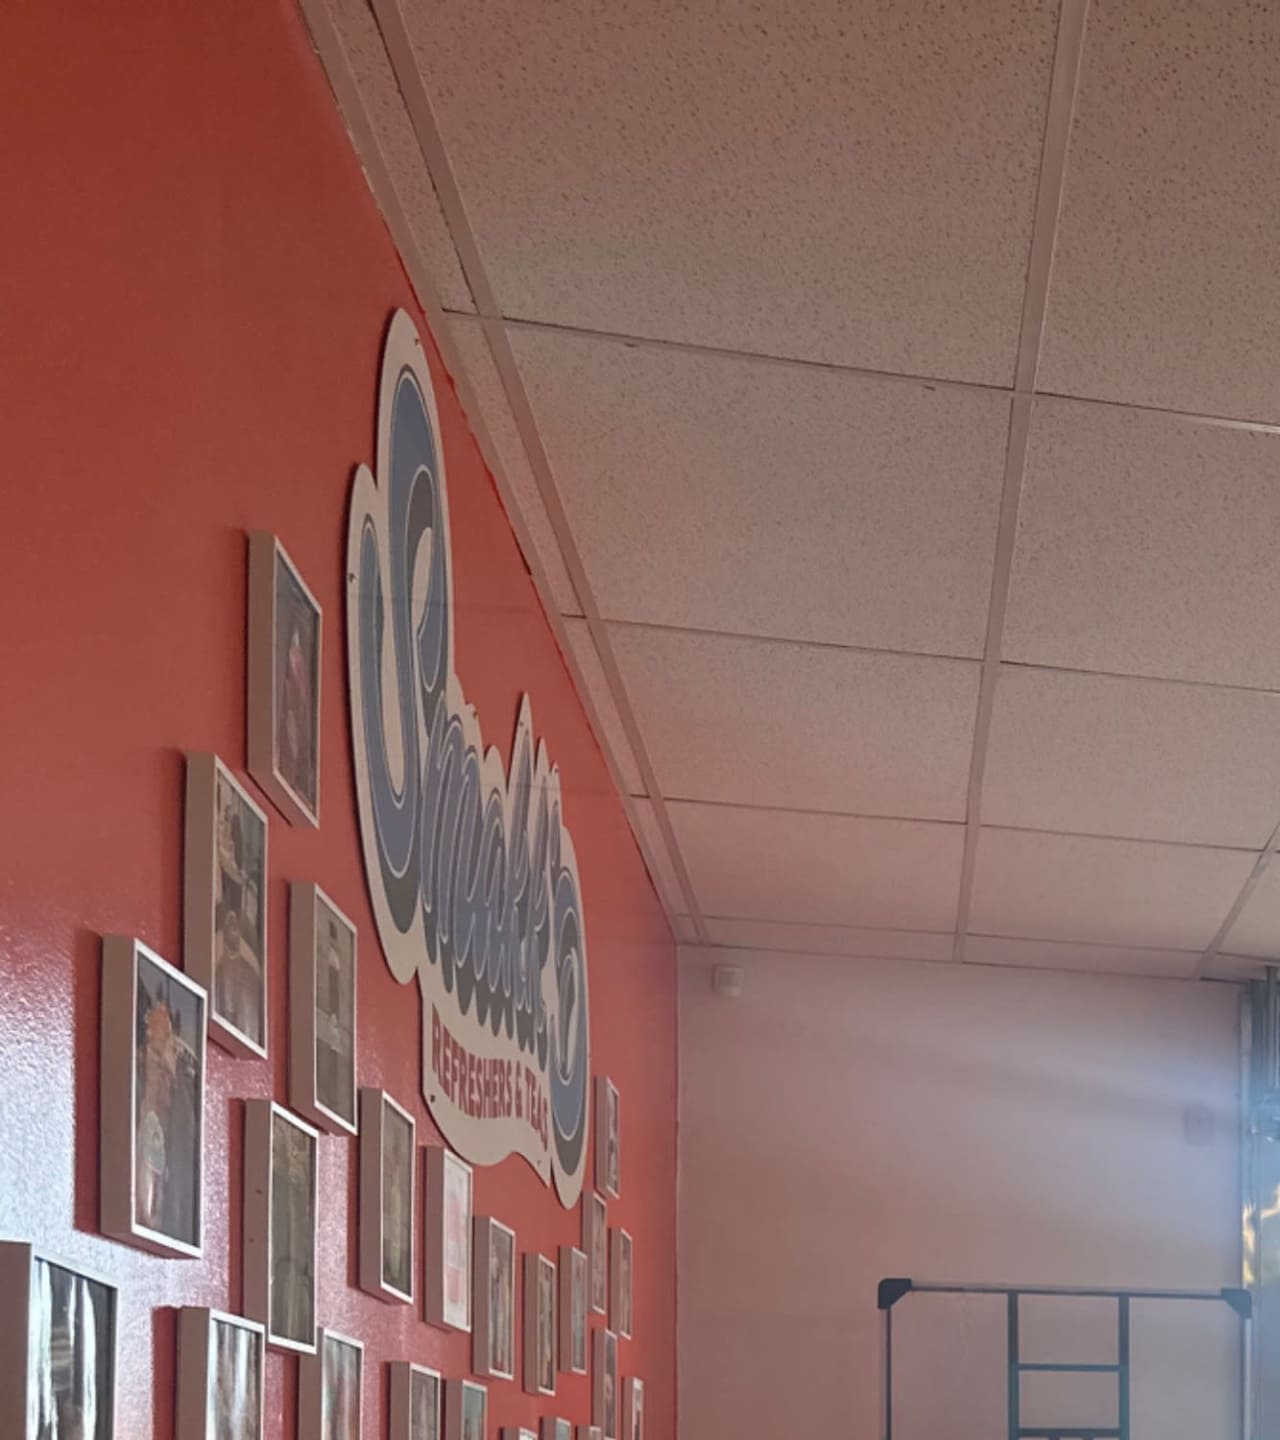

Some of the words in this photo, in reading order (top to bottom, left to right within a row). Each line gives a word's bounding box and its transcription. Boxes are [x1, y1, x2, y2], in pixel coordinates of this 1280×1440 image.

[432, 1002, 511, 1120] REFRESHERS
[515, 1060, 523, 1118] &
[525, 1064, 548, 1151] TEAS
